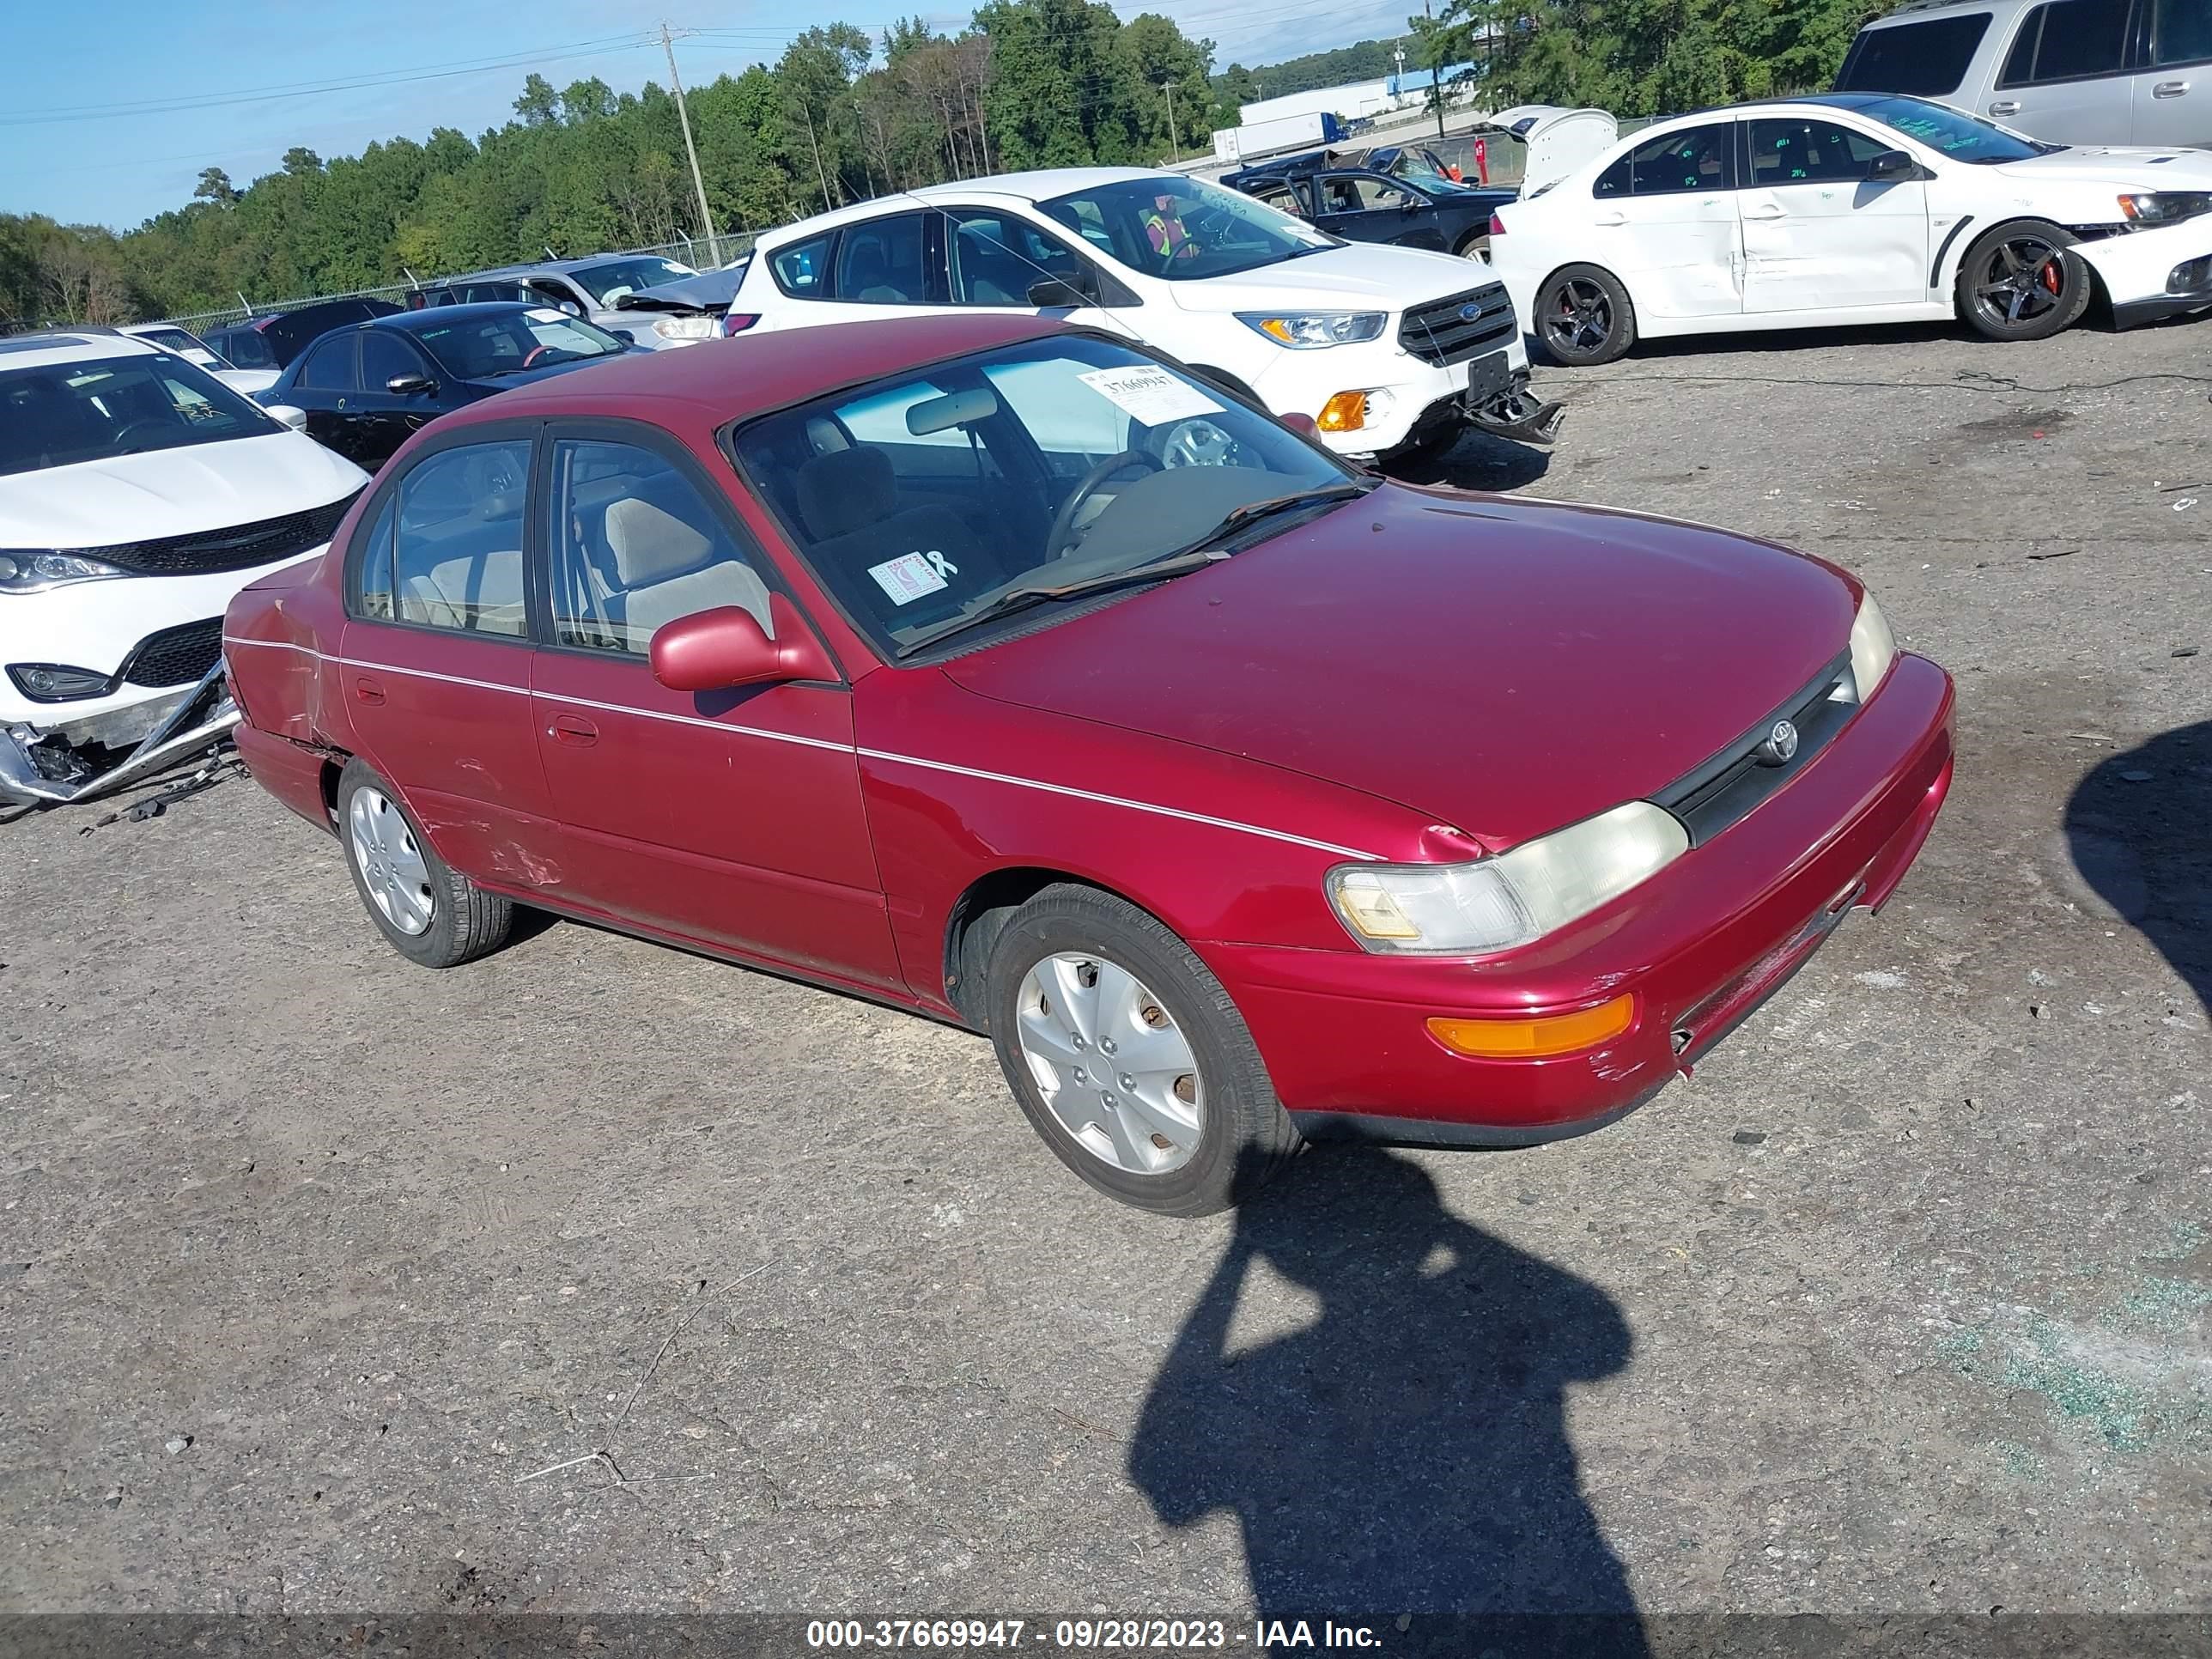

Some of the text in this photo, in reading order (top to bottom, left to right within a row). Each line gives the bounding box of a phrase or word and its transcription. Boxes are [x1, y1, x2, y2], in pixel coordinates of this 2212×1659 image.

[1103, 376, 1173, 394] 37669947
[886, 555, 937, 581] RELAY FOR LIFE
